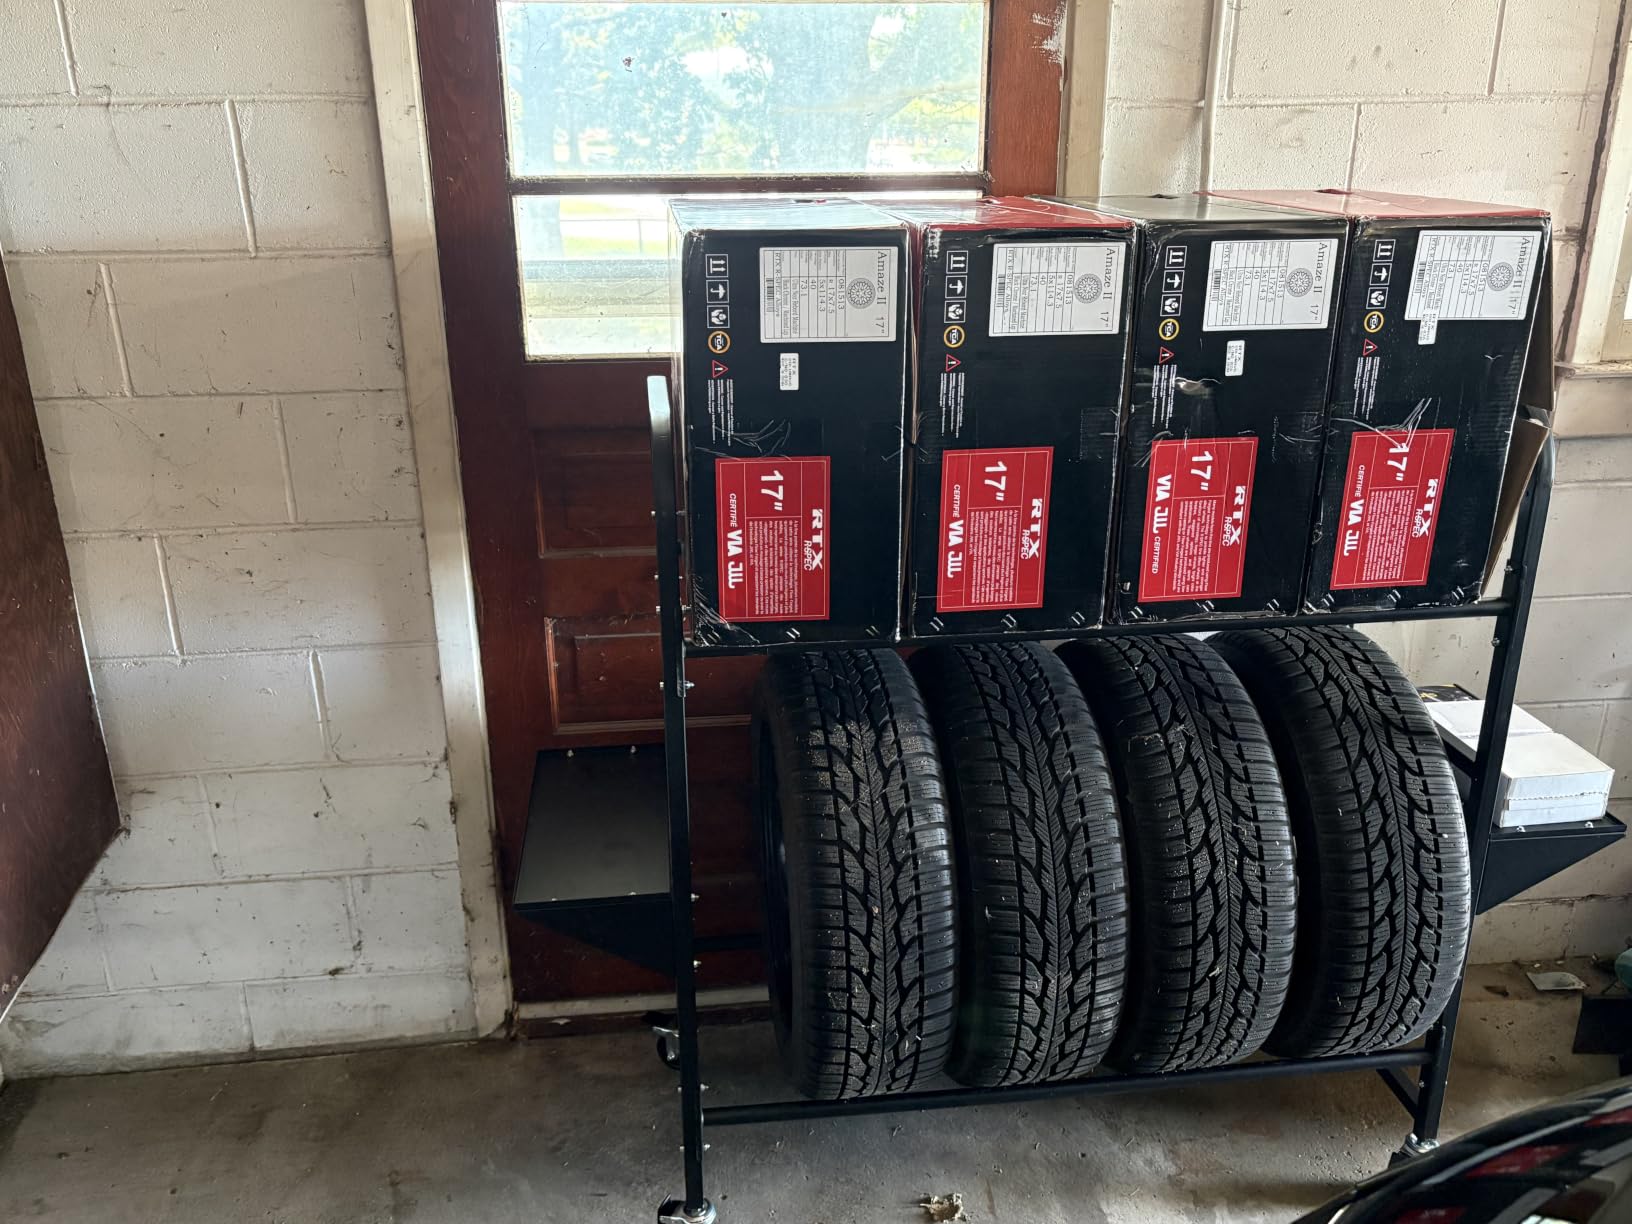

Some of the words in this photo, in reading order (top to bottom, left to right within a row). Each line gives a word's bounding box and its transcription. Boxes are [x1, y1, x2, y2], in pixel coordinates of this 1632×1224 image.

[877, 251, 887, 292] Amaze
[1103, 248, 1115, 288] Amaze
[1315, 242, 1327, 281] Amaze
[1457, 263, 1463, 272] 40
[1516, 238, 1530, 276] Amaze
[810, 280, 816, 289] 40
[1040, 275, 1046, 285] 40
[1065, 275, 1073, 304] 081513
[1254, 270, 1259, 279] 40
[1260, 269, 1268, 301] 5x114.3
[1277, 269, 1285, 299] 081513
[1461, 263, 1471, 294] 5x114.3
[1469, 270, 1478, 296] 17x7.5
[1478, 263, 1488, 292] 081513
[1513, 280, 1522, 288] II
[1047, 275, 1055, 307] 5x114.3
[1103, 292, 1112, 300] II
[1508, 298, 1517, 314] 17"
[876, 317, 884, 334] 17"
[1100, 312, 1109, 327] 17"
[1310, 304, 1318, 320] 17"
[1190, 451, 1213, 490] 17"
[1387, 442, 1409, 481] 17"
[760, 470, 783, 510] 17"
[984, 461, 1007, 501] 17"
[1156, 474, 1171, 501] VIA
[1355, 465, 1365, 497] CERTIFIÉ
[730, 493, 738, 527] CERTIFIÉ
[1230, 486, 1246, 546] RTX
[1348, 499, 1364, 525] VIA
[1412, 509, 1423, 537] R-SPEC
[1420, 479, 1438, 537] RTX
[727, 529, 742, 556] VIA
[812, 509, 823, 571] RTX
[949, 520, 964, 546] VIA
[1029, 498, 1042, 558] RTX
[1222, 516, 1232, 546] R-SPEC
[804, 540, 812, 571] R-SPEC
[1021, 530, 1030, 560] R-SPEC
[1152, 536, 1160, 573] CERTIFIED
